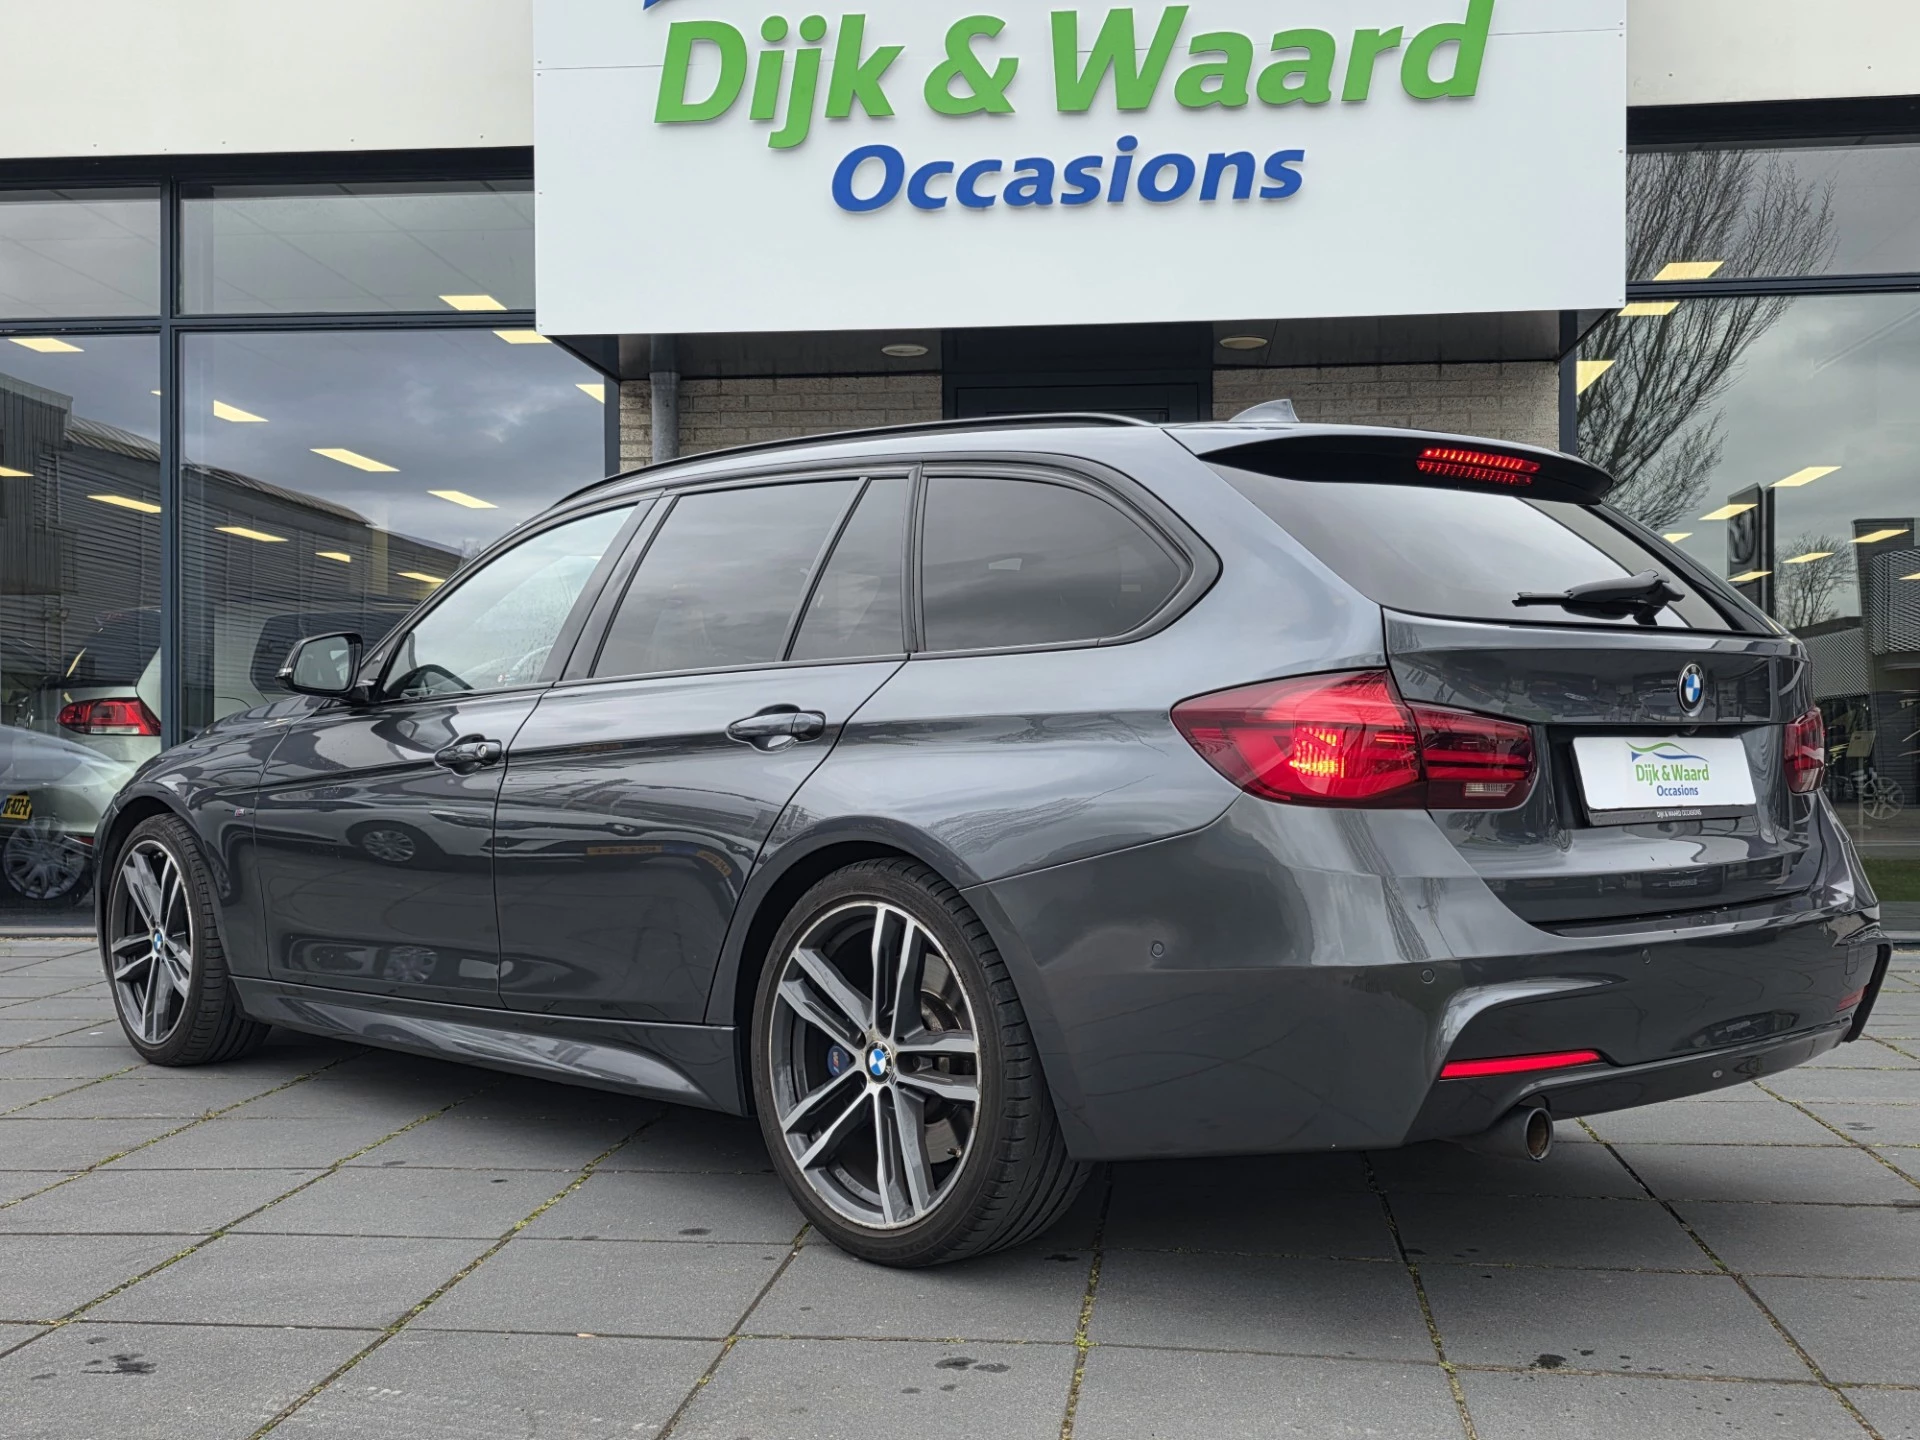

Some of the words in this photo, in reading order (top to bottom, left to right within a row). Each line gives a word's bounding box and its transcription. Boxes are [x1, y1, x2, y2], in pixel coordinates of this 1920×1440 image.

[656, 14, 901, 148] Dijk
[925, 16, 1018, 115] &
[1052, 0, 1494, 111] Waard
[832, 135, 1305, 212] Occasions
[1635, 764, 1660, 786] Dijk
[1662, 765, 1671, 781] &
[1671, 764, 1710, 781] Waard
[1656, 784, 1699, 797] Occasions
